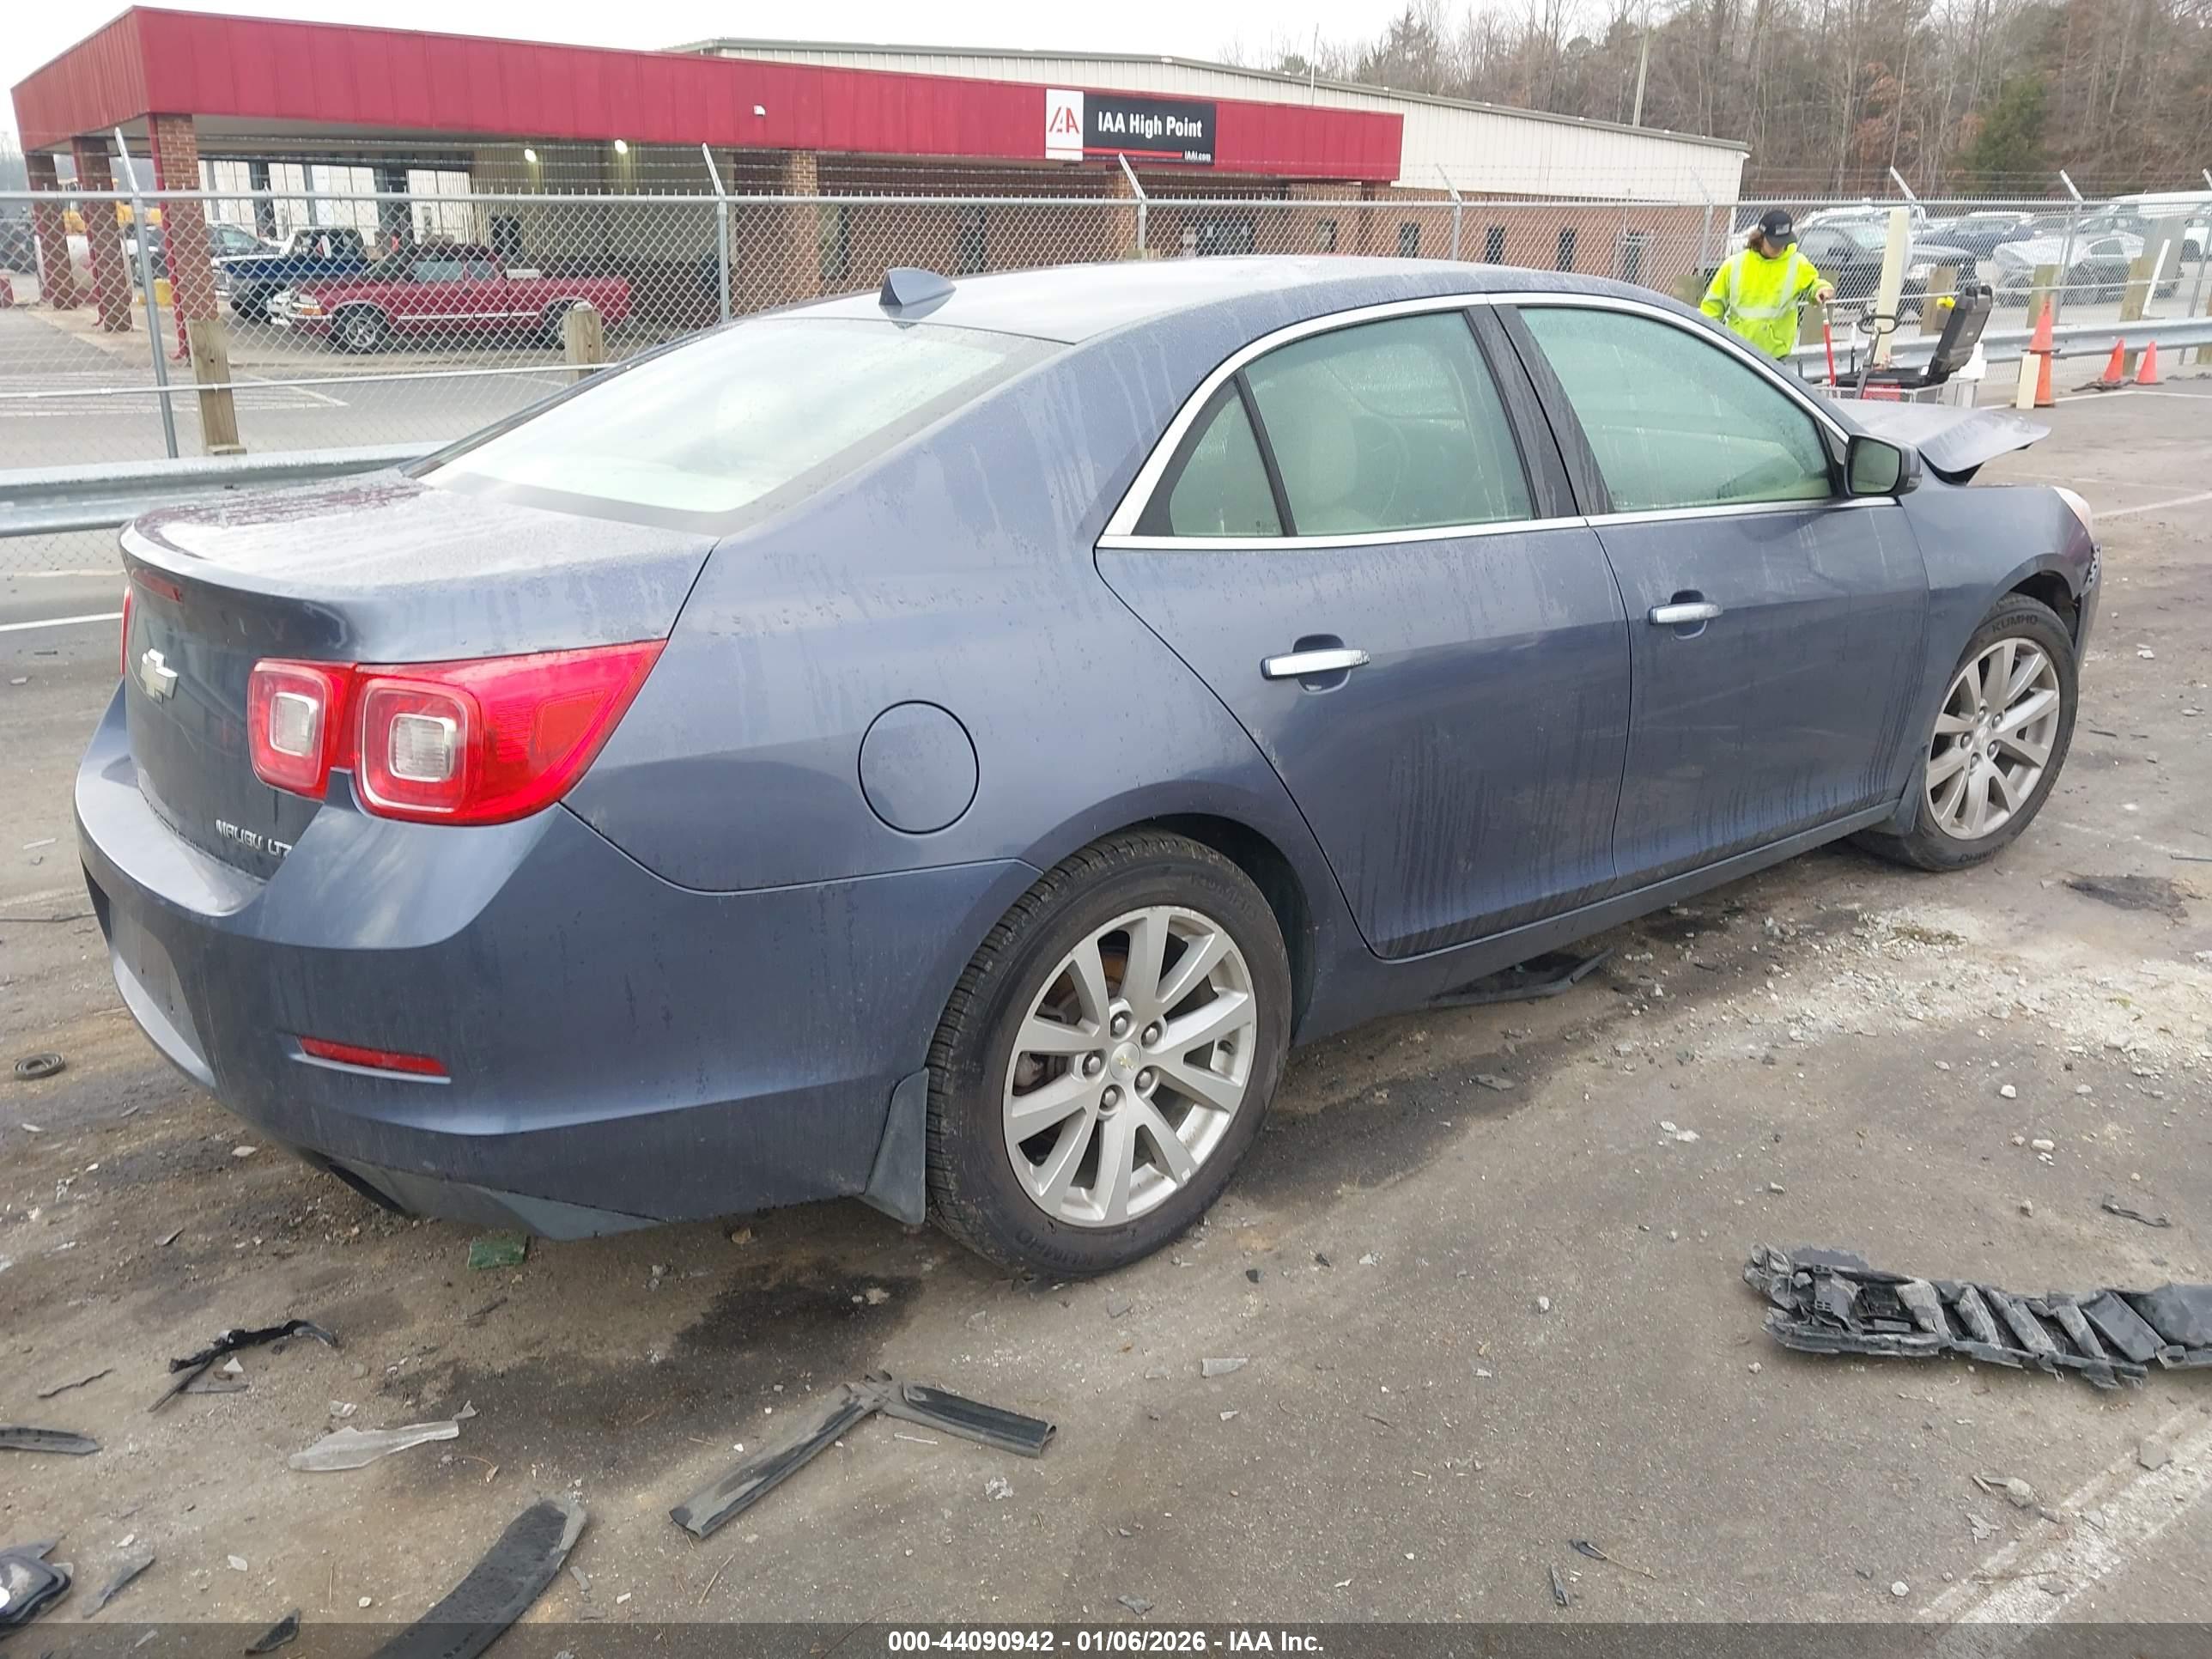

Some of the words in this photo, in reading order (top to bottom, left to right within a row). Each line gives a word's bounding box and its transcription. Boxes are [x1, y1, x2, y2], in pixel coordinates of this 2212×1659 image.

[1097, 111, 1126, 133] IAA
[1129, 113, 1162, 139] High
[1166, 116, 1203, 138] Point
[1991, 613, 2039, 633] KUMHO
[215, 818, 264, 851] MALIBU
